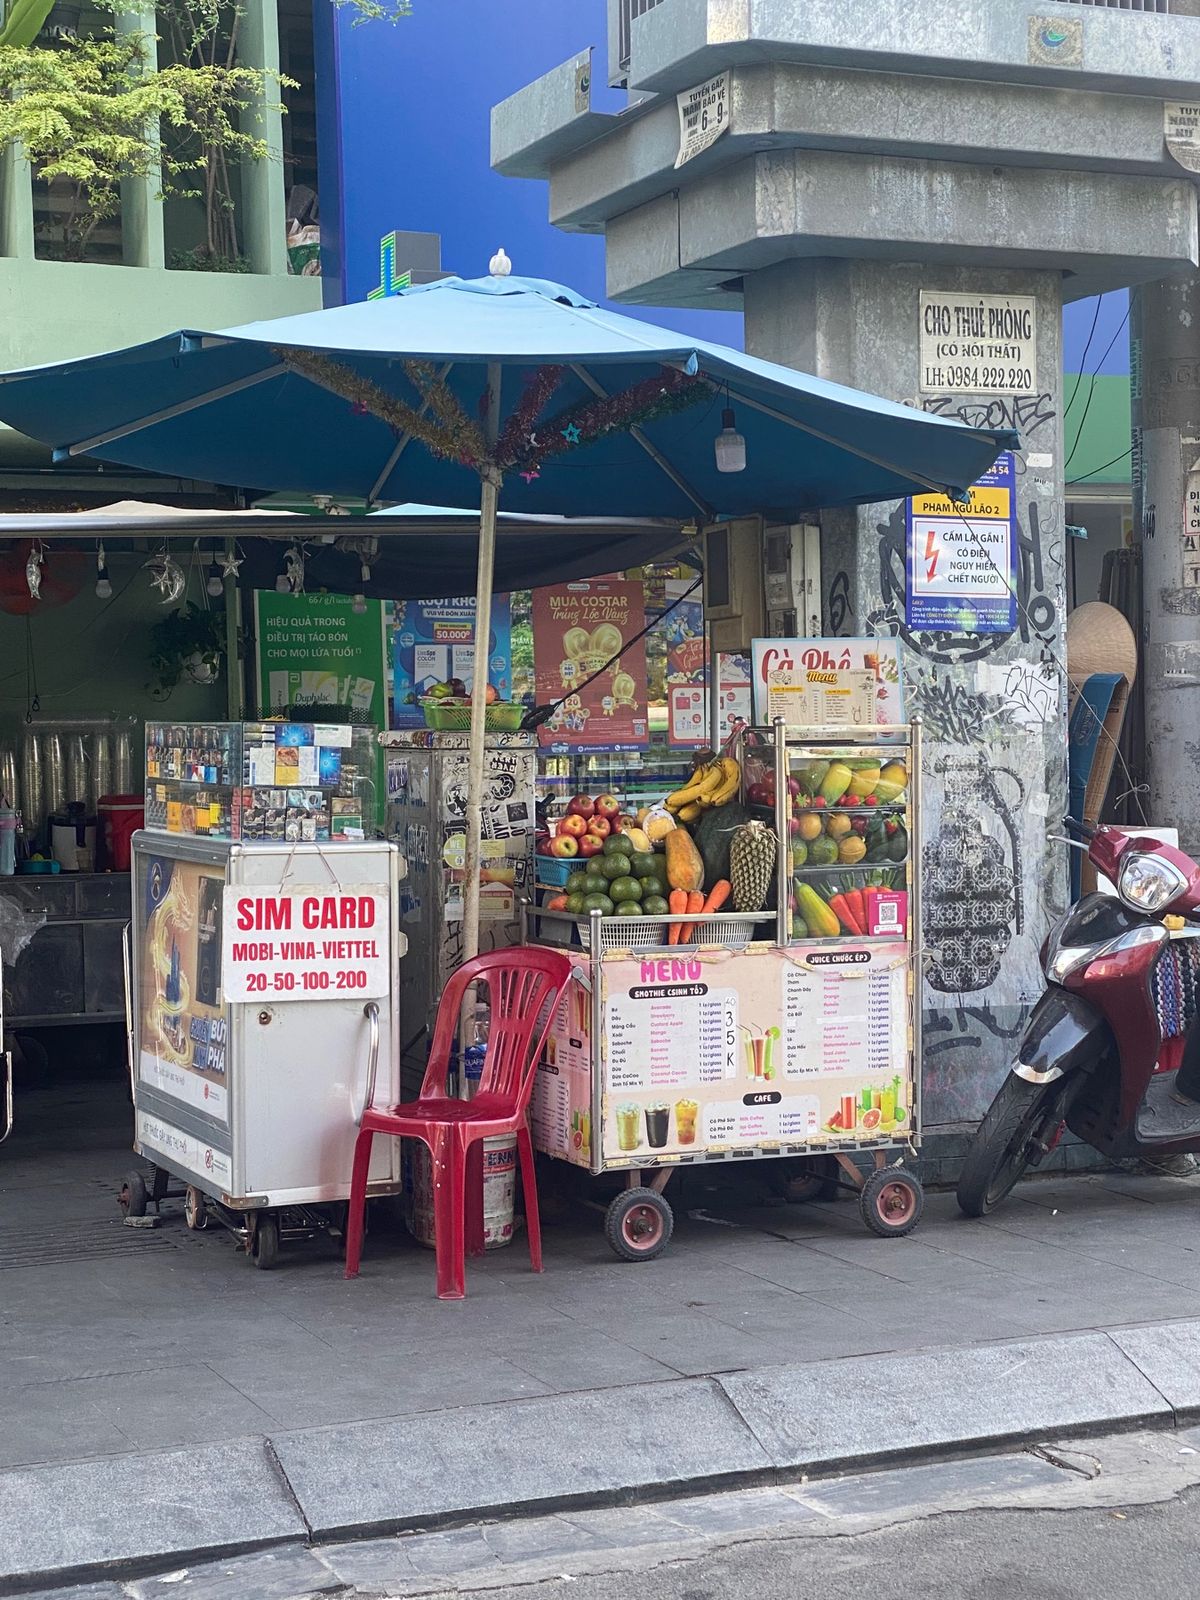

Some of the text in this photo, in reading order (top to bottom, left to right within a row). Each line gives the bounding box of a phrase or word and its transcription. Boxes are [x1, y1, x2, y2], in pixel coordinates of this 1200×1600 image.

[703, 94, 715, 108] BẢO
[717, 86, 725, 100] VỆ
[702, 110, 707, 130] 6
[717, 102, 722, 123] 9
[924, 300, 1031, 340] CHO THUÊ PHÒNG
[937, 342, 1021, 362] (CÓ NỘI THẤT)
[926, 366, 1031, 389] LH: 0984.222.220
[999, 466, 1009, 474] 54
[923, 502, 950, 515] PHẠM
[974, 502, 992, 514] LÃO
[994, 506, 999, 514] 2
[943, 529, 963, 542] CẤM
[965, 534, 978, 544] LẠI
[980, 531, 999, 543] GẦN
[957, 548, 990, 560] CÓ ĐIỆN
[950, 560, 997, 571] NGUY HIỂM
[948, 572, 999, 584] CHẾT NGƯỜI
[550, 596, 627, 608] MUA COSTAR
[267, 615, 346, 628] HIỆU QUẢ TRONG
[552, 606, 630, 625] Trúng Lộc Vàng
[267, 631, 348, 643] ĐIỀU TRỊ TÁO BÓN
[267, 647, 354, 658] CHO MỌI LỨA TUỔI
[762, 648, 794, 684] Cà
[806, 671, 838, 685] Menu
[237, 896, 375, 931] SIM CARD
[232, 940, 379, 961] MOBI-VINA-VIETTEL
[810, 956, 830, 964] JUICE
[641, 960, 701, 983] MENU
[246, 970, 367, 991] 20-50-100-200
[635, 990, 665, 998] SMOTHIE
[754, 1094, 772, 1103] CAFE
